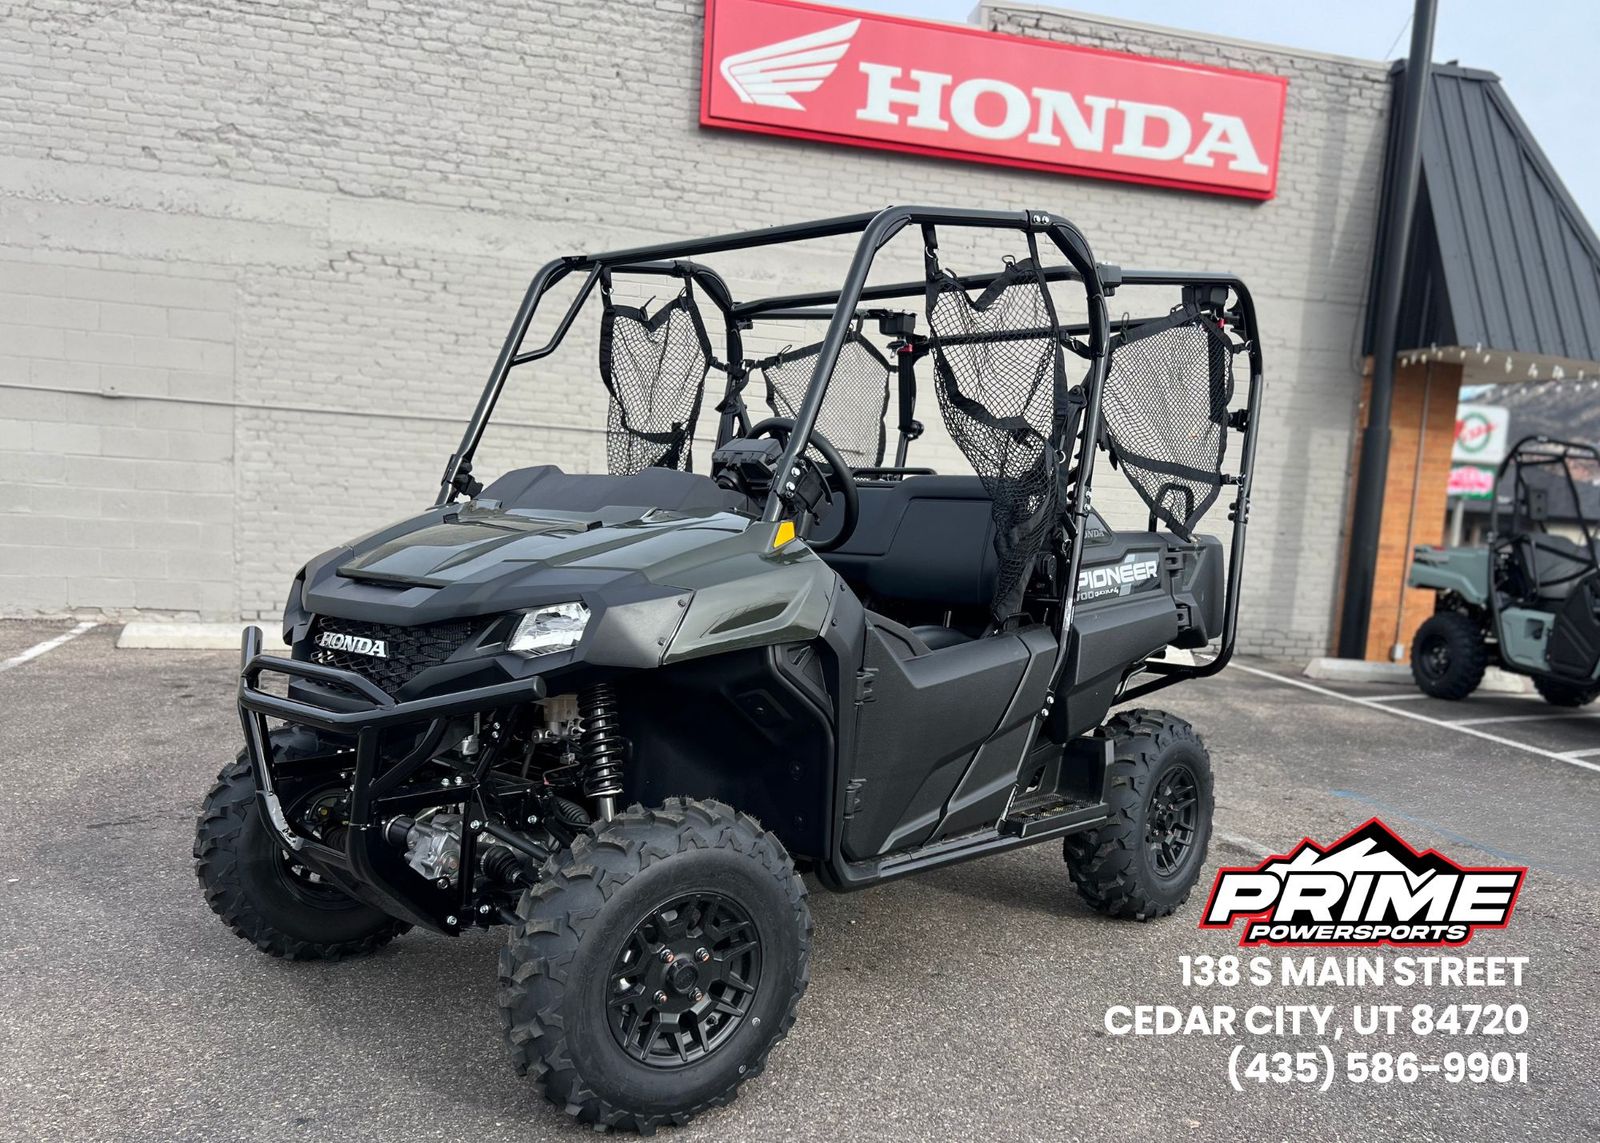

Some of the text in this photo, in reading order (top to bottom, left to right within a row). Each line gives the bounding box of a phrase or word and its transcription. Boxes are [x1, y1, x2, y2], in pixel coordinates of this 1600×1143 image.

[855, 61, 1269, 175] HONDA
[1077, 560, 1158, 591] PIONEER
[319, 631, 387, 658] HONDA
